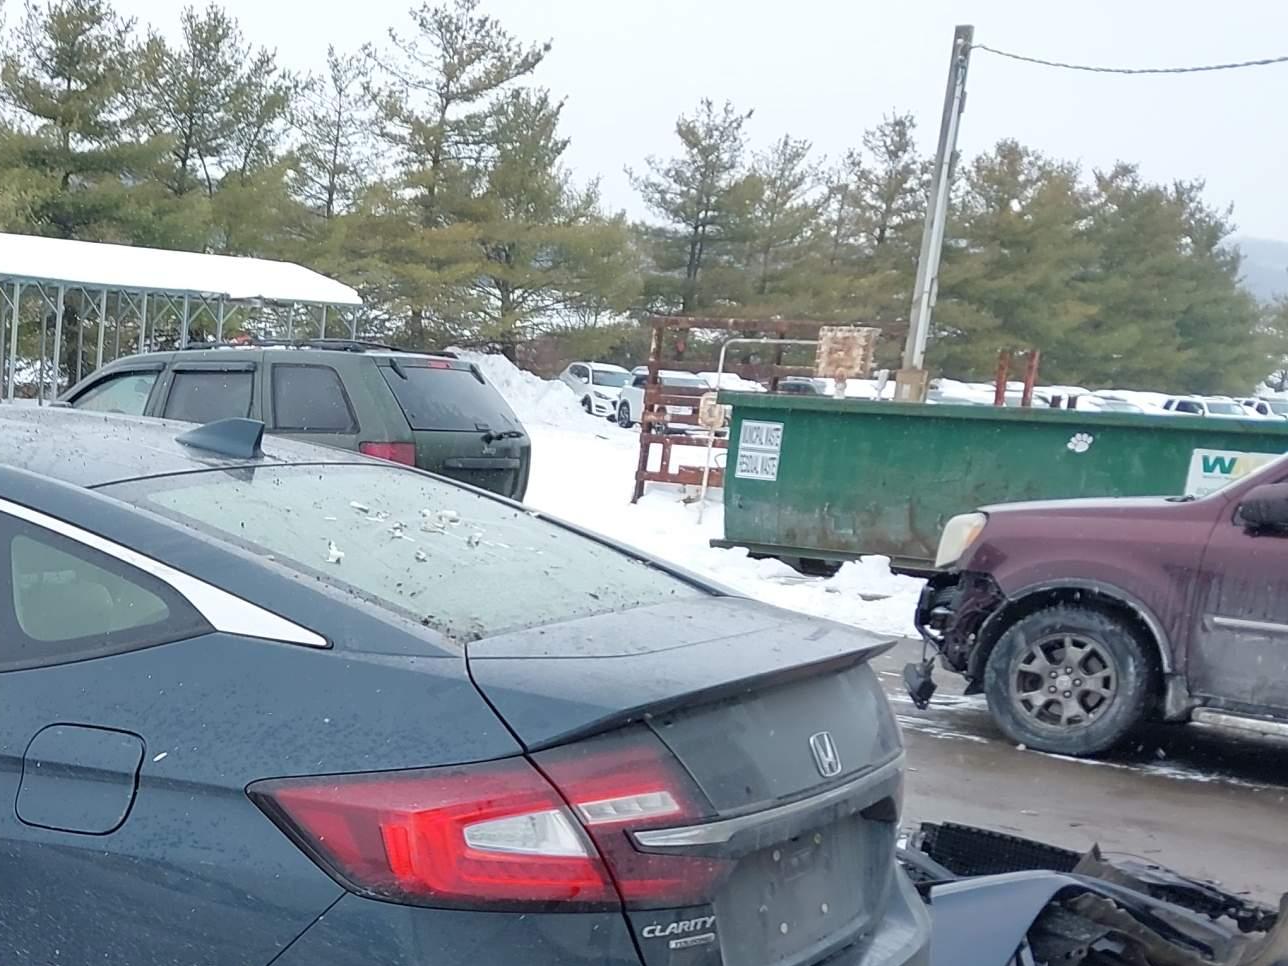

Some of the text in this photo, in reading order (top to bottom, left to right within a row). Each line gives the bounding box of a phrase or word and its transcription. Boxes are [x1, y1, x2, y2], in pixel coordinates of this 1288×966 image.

[765, 426, 781, 447] WASTE
[738, 454, 777, 475] RESIDUAL WASTE
[642, 915, 716, 937] CLARITY
